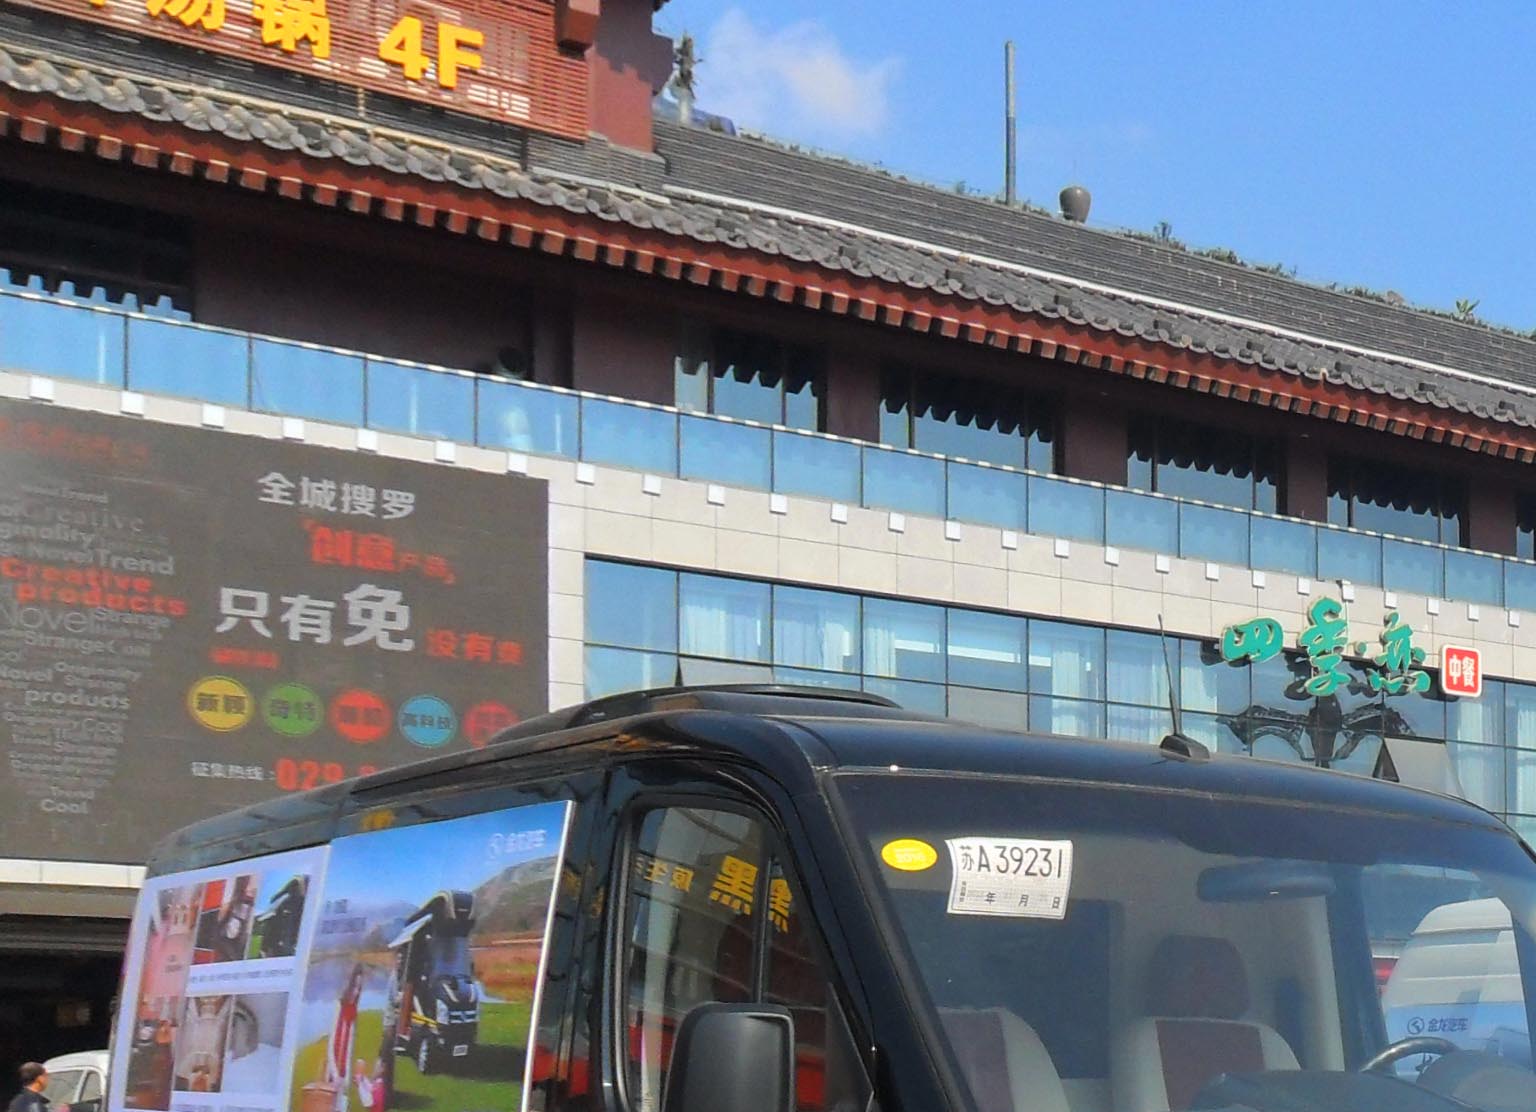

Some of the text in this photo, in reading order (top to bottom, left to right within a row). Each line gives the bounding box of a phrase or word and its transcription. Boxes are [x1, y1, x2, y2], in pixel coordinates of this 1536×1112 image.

[378, 16, 484, 88] 4F
[257, 471, 416, 520] 全城搜罗
[1, 556, 154, 593] Creative
[96, 547, 175, 576] Trend
[17, 581, 190, 618] products
[216, 583, 416, 652] 只有免
[1449, 652, 1476, 688] 中餐
[24, 687, 132, 711] products
[959, 845, 1063, 879] 苏A39231
